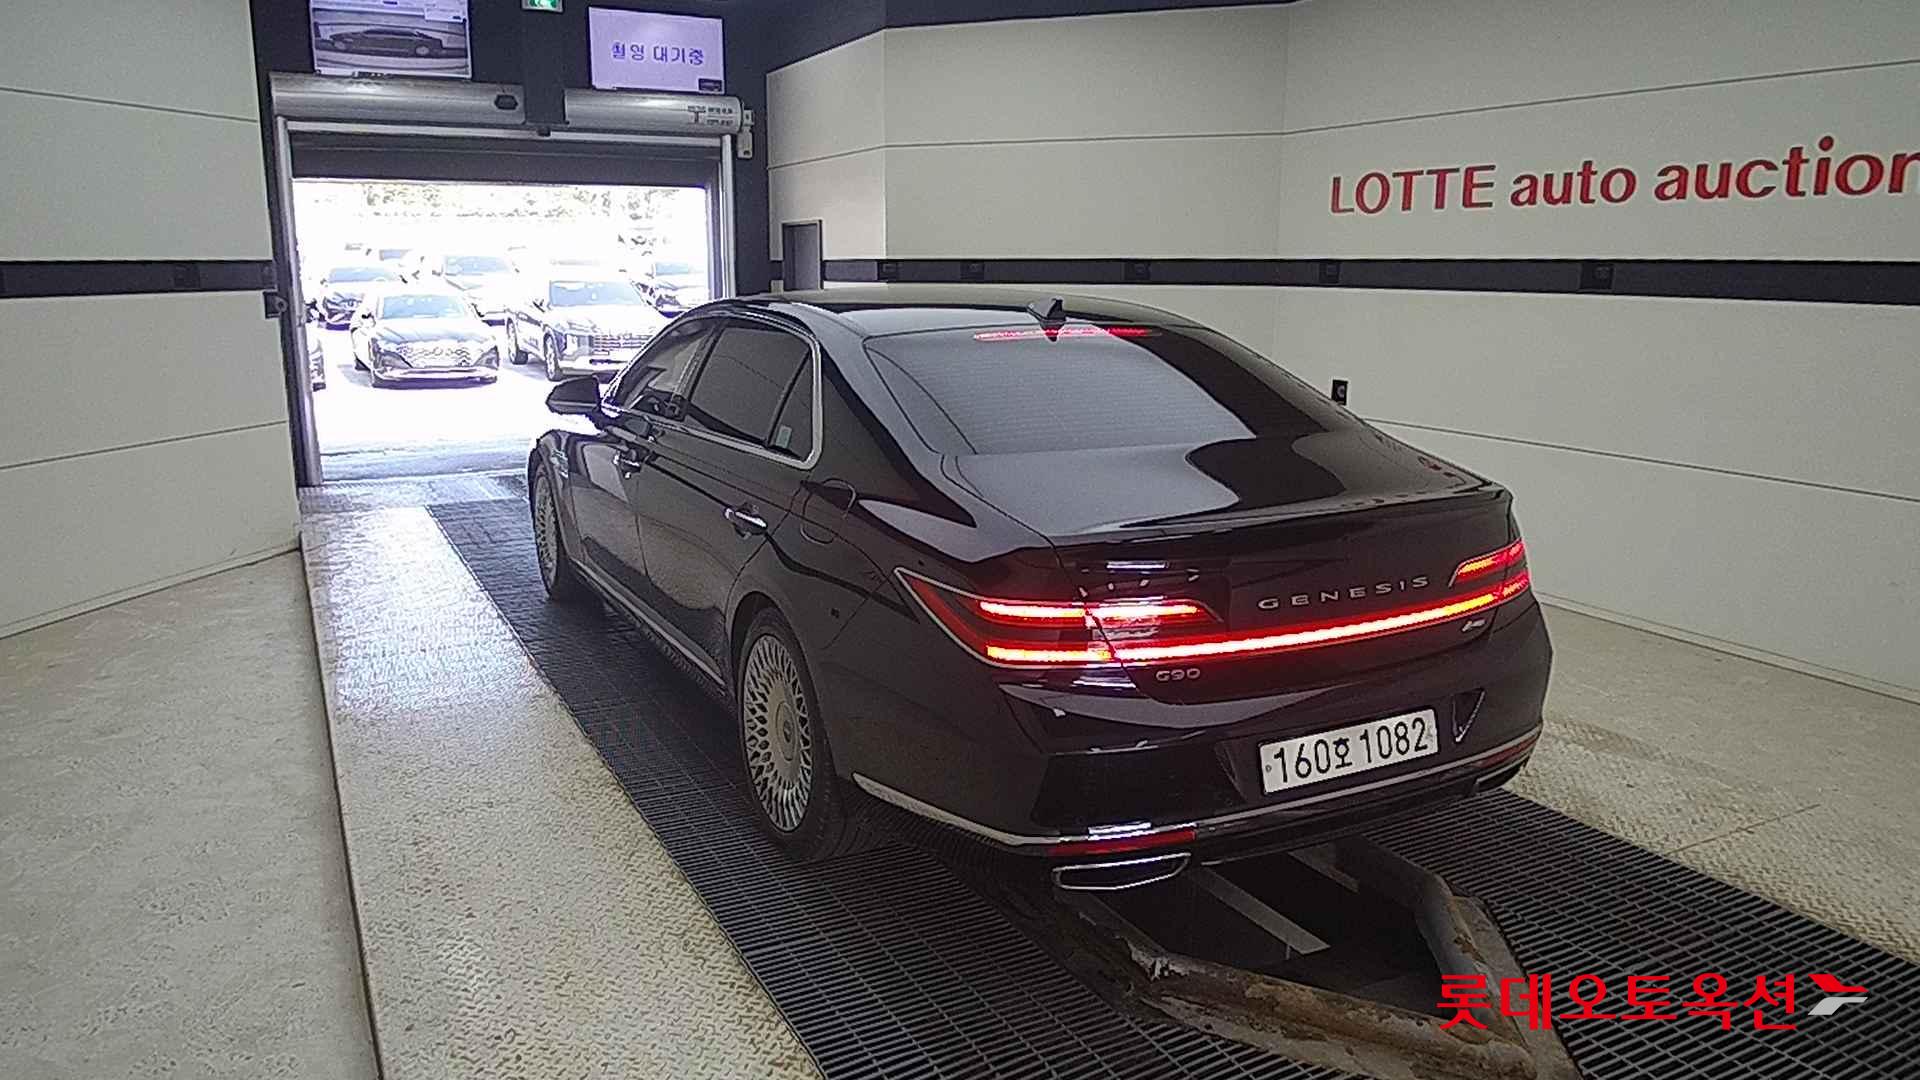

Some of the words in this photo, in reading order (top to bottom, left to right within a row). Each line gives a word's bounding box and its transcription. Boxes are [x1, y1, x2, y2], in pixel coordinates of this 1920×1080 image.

[653, 45, 704, 66] 대기중
[1331, 164, 1496, 215] LOTTE
[1510, 160, 1637, 207] auto
[1258, 576, 1430, 610] GENESIS
[1155, 668, 1201, 683] G90
[1272, 737, 1351, 783] 160호
[1359, 717, 1429, 764] 1082
